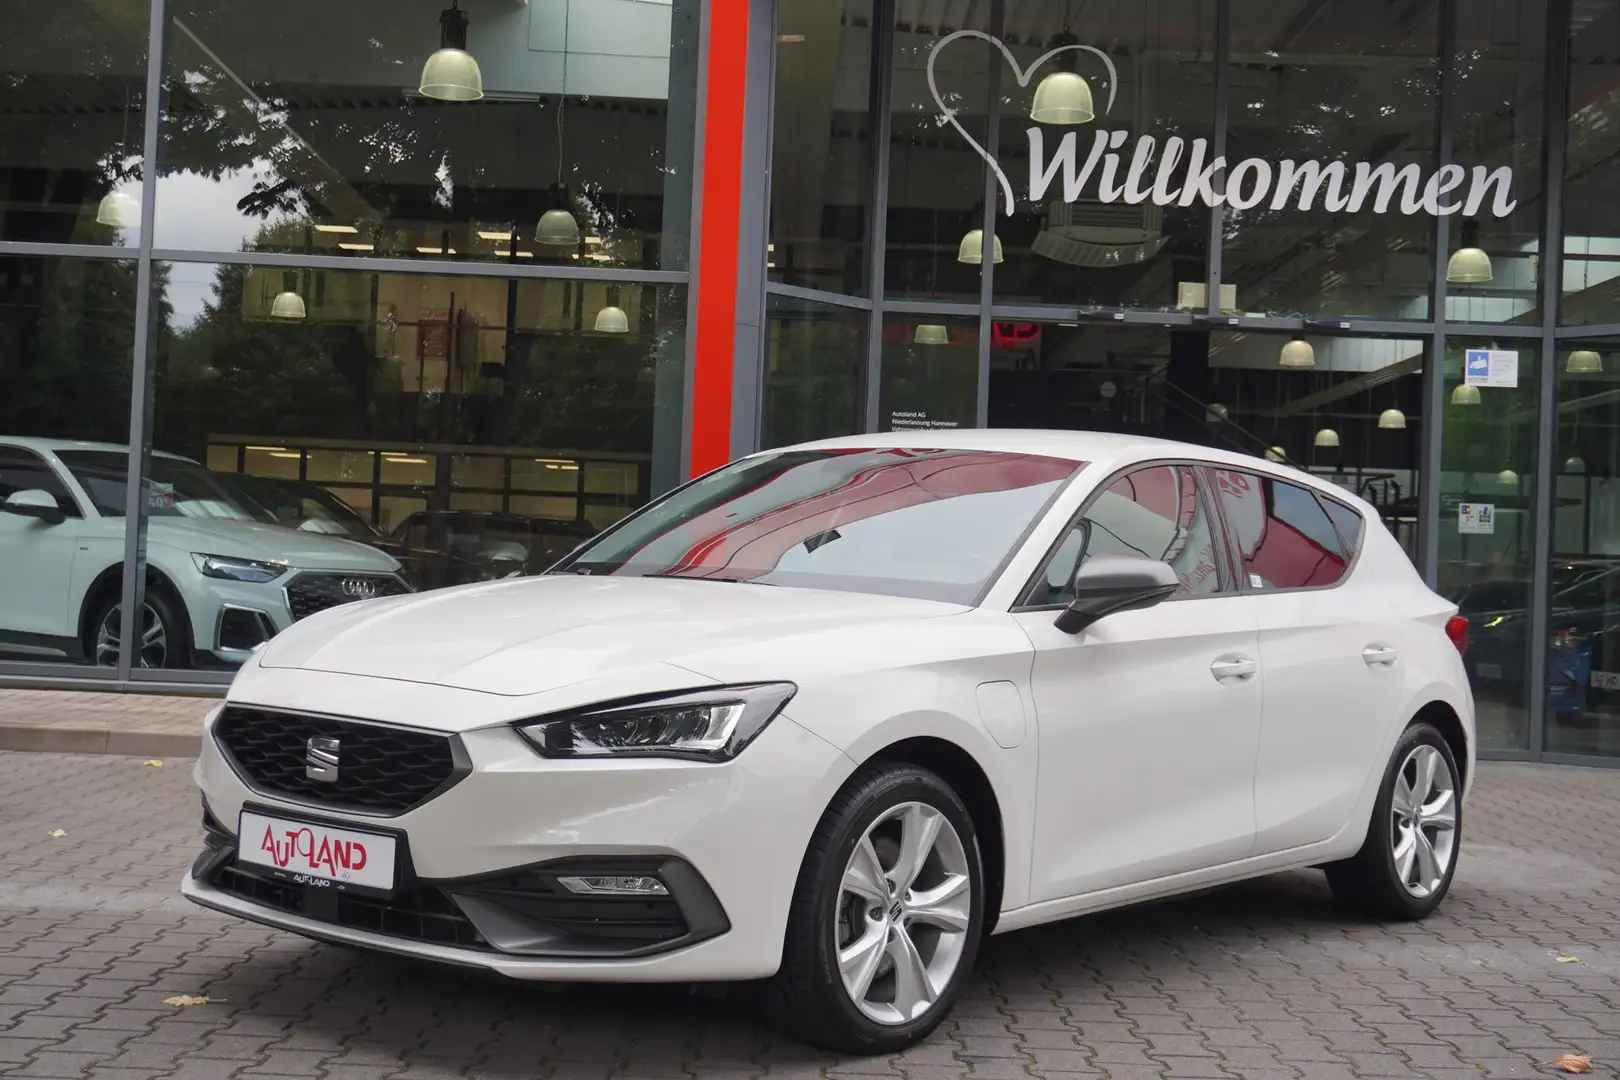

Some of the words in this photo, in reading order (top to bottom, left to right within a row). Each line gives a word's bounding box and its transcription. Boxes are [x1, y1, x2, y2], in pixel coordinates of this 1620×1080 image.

[1026, 127, 1517, 218] Willkommen
[891, 419, 930, 427] Niederlassung
[261, 823, 367, 877] AUTOLAND
